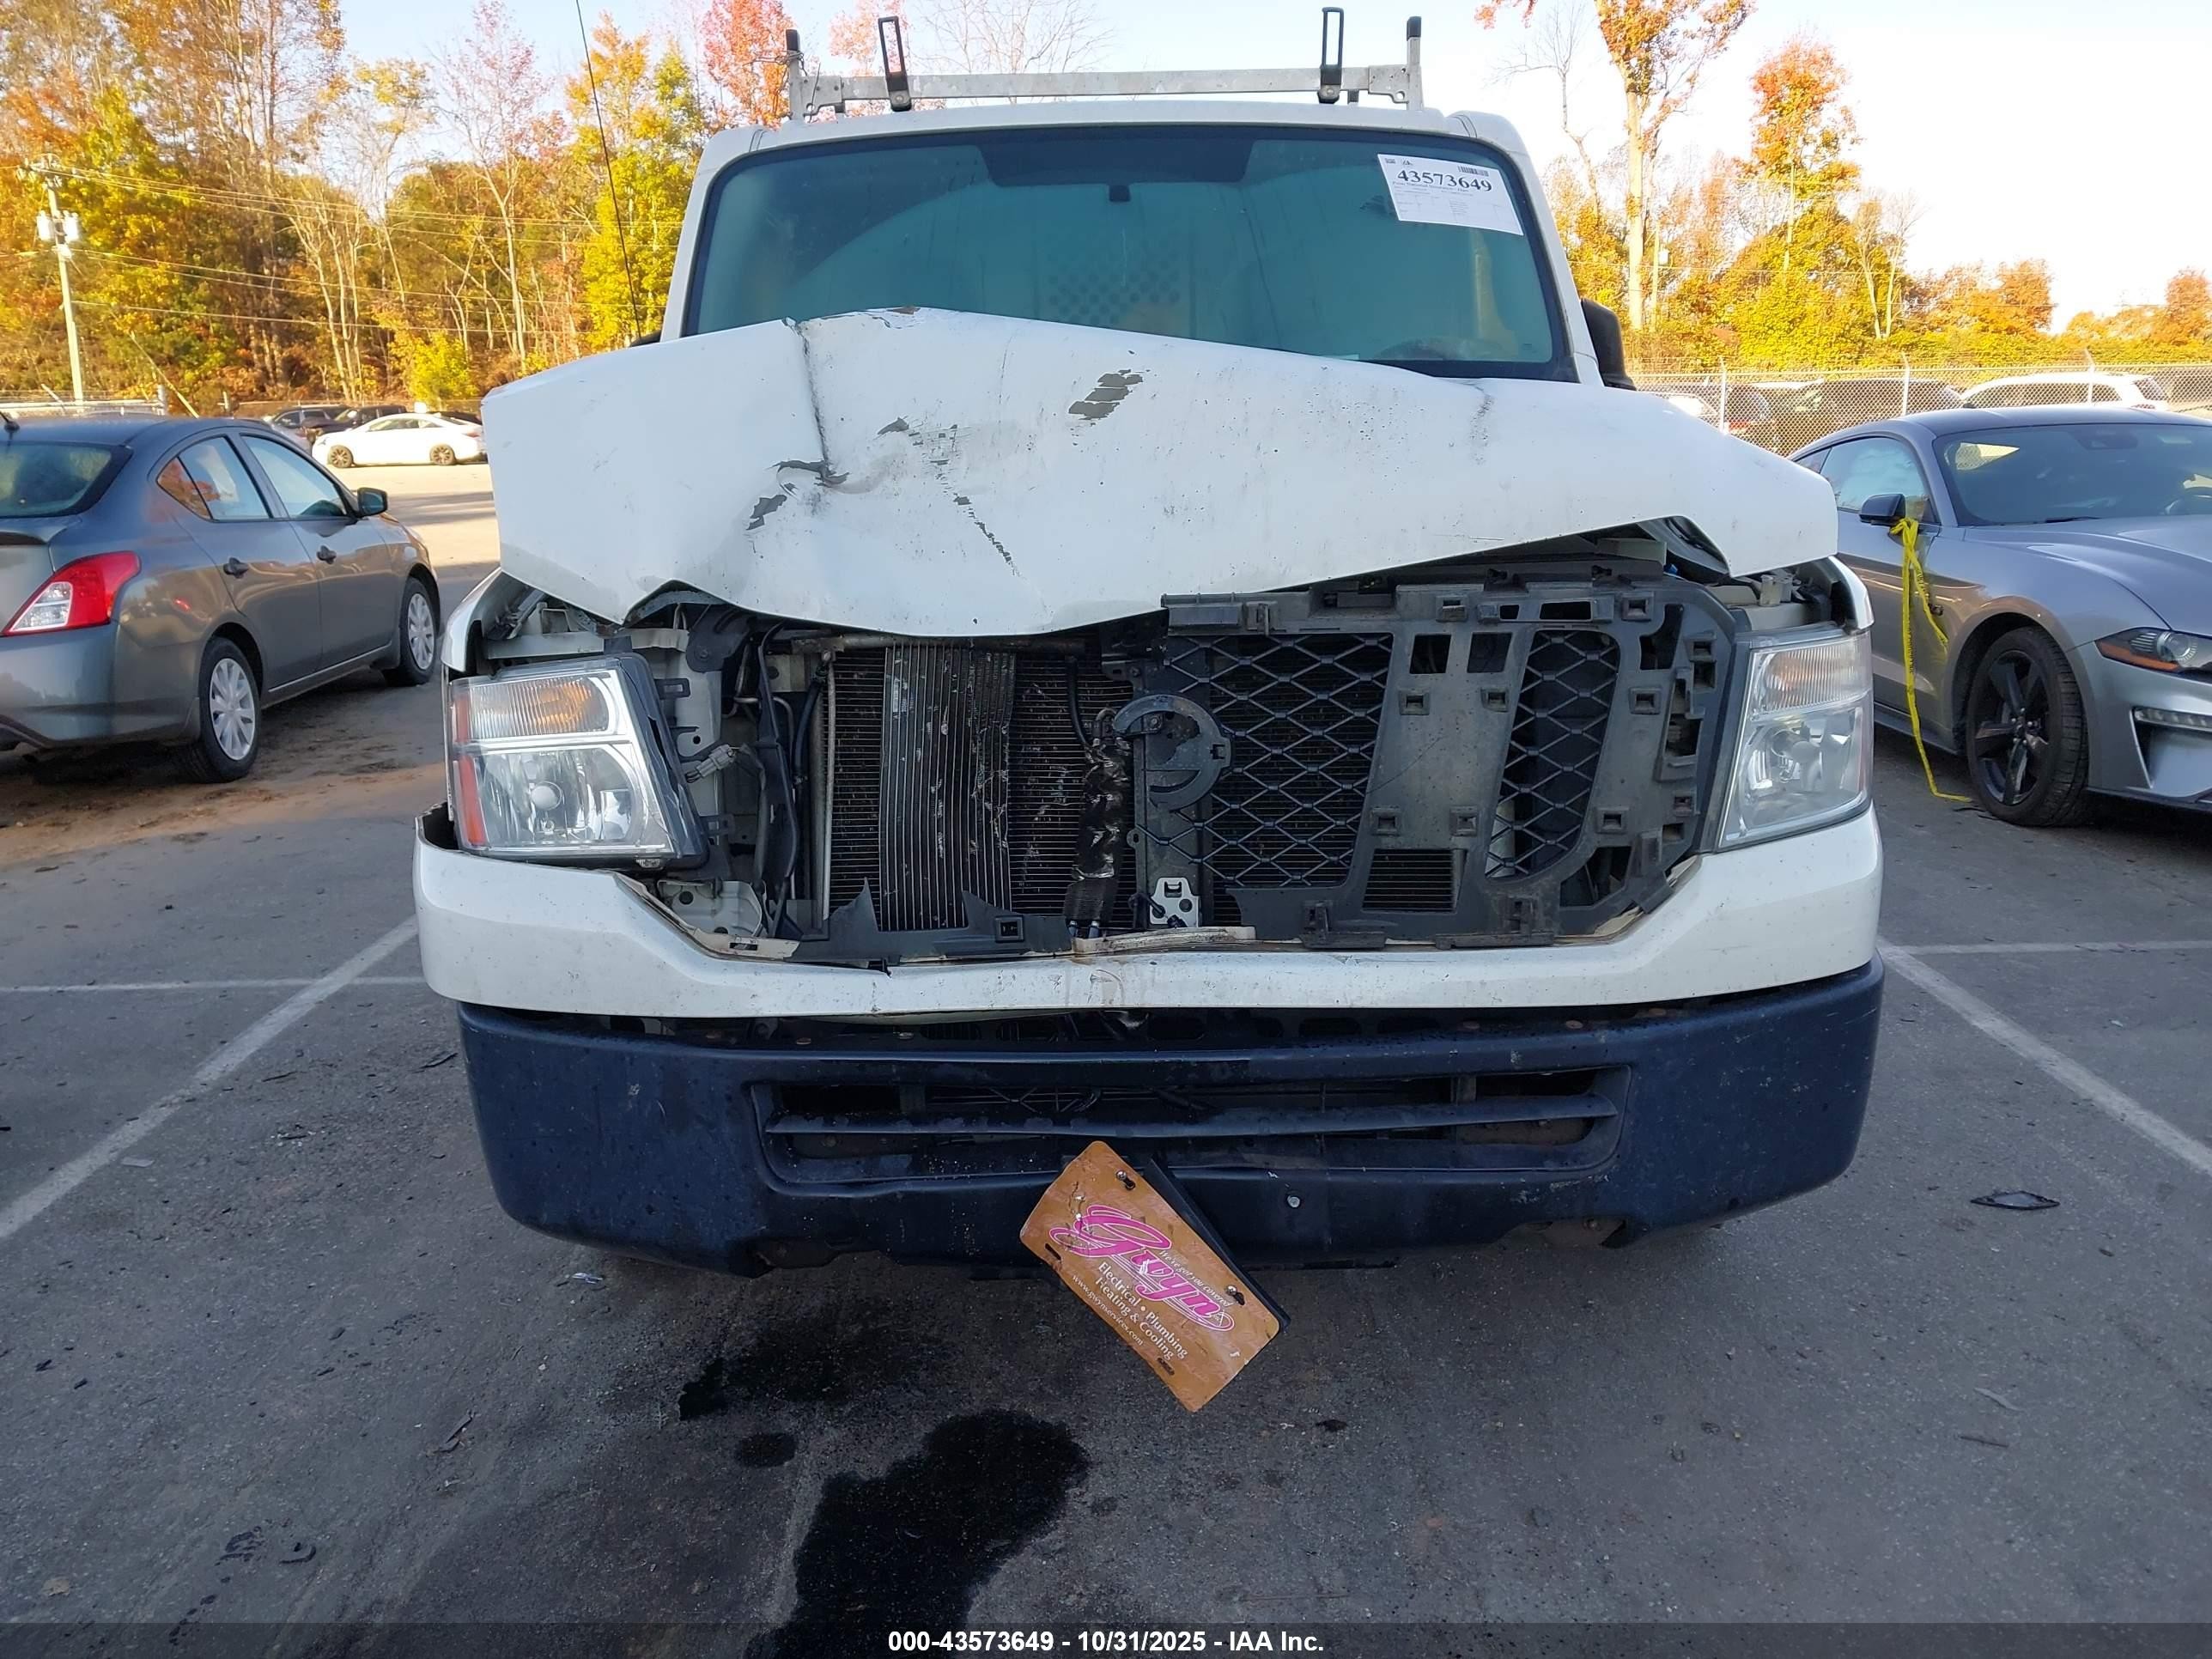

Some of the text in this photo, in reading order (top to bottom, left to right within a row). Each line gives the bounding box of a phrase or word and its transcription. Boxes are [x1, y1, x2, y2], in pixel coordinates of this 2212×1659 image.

[1397, 169, 1492, 191] 43573649
[1049, 1205, 1226, 1319] Gwyn
[1188, 1276, 1204, 1287] you
[1203, 1286, 1234, 1307] covered
[1095, 1278, 1175, 1360] Heating & Cooling
[1098, 1261, 1188, 1359] Electrical Plumbing
